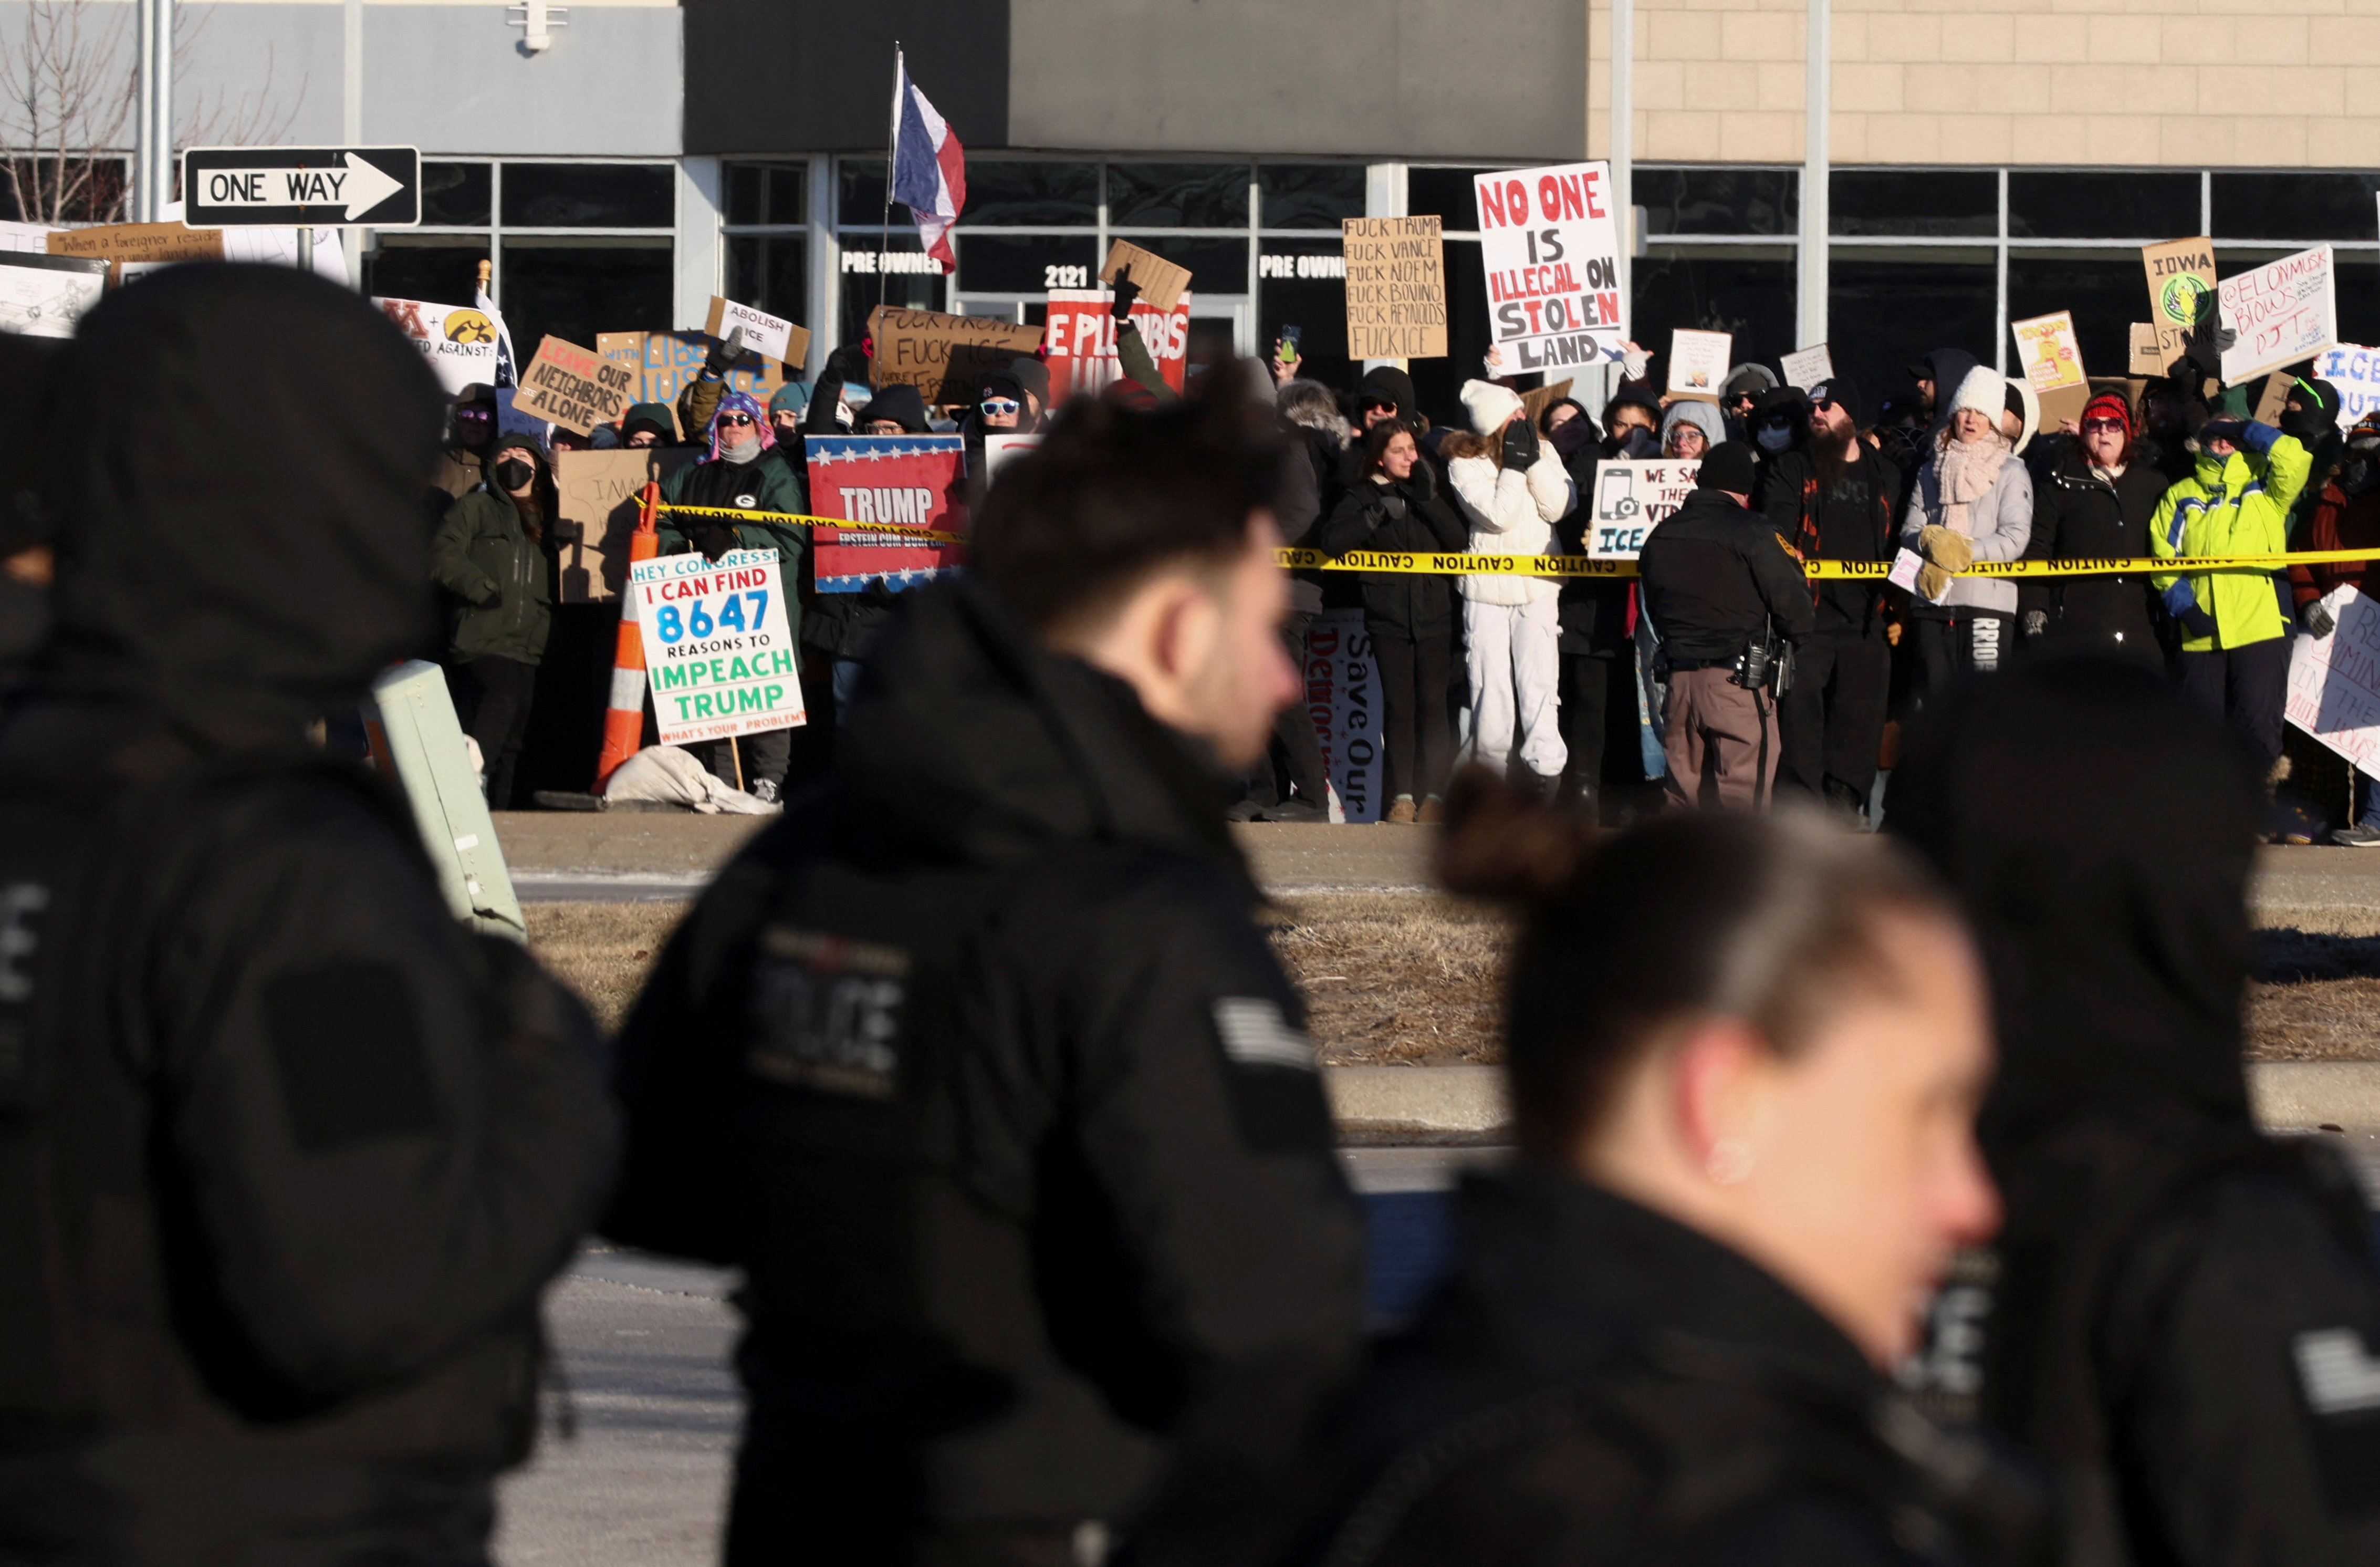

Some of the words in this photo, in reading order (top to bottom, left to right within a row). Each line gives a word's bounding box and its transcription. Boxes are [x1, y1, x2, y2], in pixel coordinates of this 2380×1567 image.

[210, 174, 266, 202] ONE
[287, 173, 347, 201] WAY
[1479, 179, 1529, 229] NO
[1538, 171, 1605, 222] ONE
[1345, 219, 1390, 237] FUCK
[1394, 217, 1442, 236] TRUMP
[102, 238, 109, 247] a
[114, 233, 168, 252] foreigner
[1345, 243, 1386, 261] FUCK
[1390, 239, 1437, 258] VANCE
[1527, 229, 1564, 264] IS
[842, 252, 877, 274] PRE
[1259, 255, 1294, 277] PRE
[1297, 256, 1346, 278] OWN
[1346, 265, 1385, 282] FUCK
[1392, 260, 1437, 282] NOEM
[2153, 252, 2213, 276] IOWA
[1045, 265, 1087, 287] 2121
[1490, 263, 1581, 302] ILLEGAL
[1586, 256, 1617, 289] ON
[1348, 284, 1387, 303] FUCK
[1391, 283, 1442, 302] BOVINO
[730, 307, 785, 332] ABOLISH
[1348, 305, 1386, 324] FUCK
[1391, 303, 1446, 325] REYNOLDS
[1498, 292, 1619, 337] STOLEN
[744, 328, 764, 343] ICE
[1047, 314, 1070, 356] E
[2160, 323, 2217, 350] STRON
[437, 344, 494, 357] AGAINST:
[604, 349, 640, 360] WITH
[897, 338, 953, 366] FUCK
[1517, 334, 1599, 369] LAND
[539, 340, 597, 378] LEAVE
[597, 365, 632, 393] OUR
[533, 362, 622, 417] NEIGHBORS
[629, 365, 773, 405] JUSCE
[531, 390, 595, 428] ALONE
[1645, 468, 1666, 483] WE
[1678, 468, 1699, 483] SA
[839, 486, 933, 524] TRUMP
[1658, 488, 1688, 501] THE
[839, 532, 878, 547] EPSTEIN
[1598, 527, 1644, 553] ICE
[1335, 553, 1414, 568] CAUTION
[1433, 555, 1514, 571] CAUTION
[1535, 557, 1616, 573] CAUTION
[634, 564, 667, 583] HEY
[646, 586, 653, 605] I
[661, 577, 709, 601] CAN
[715, 568, 767, 593] FIND
[656, 589, 769, 644] 8647
[667, 637, 743, 659] REASONS
[751, 634, 771, 648] TO
[651, 648, 794, 692] IMPEACH
[1346, 634, 1374, 730] Save
[674, 684, 784, 721] TRUMP
[2293, 661, 2325, 701] IN
[2335, 689, 2379, 729] THE
[661, 725, 704, 743] WHAT'S
[707, 722, 738, 735] YOUR
[1345, 738, 1374, 814] Our
